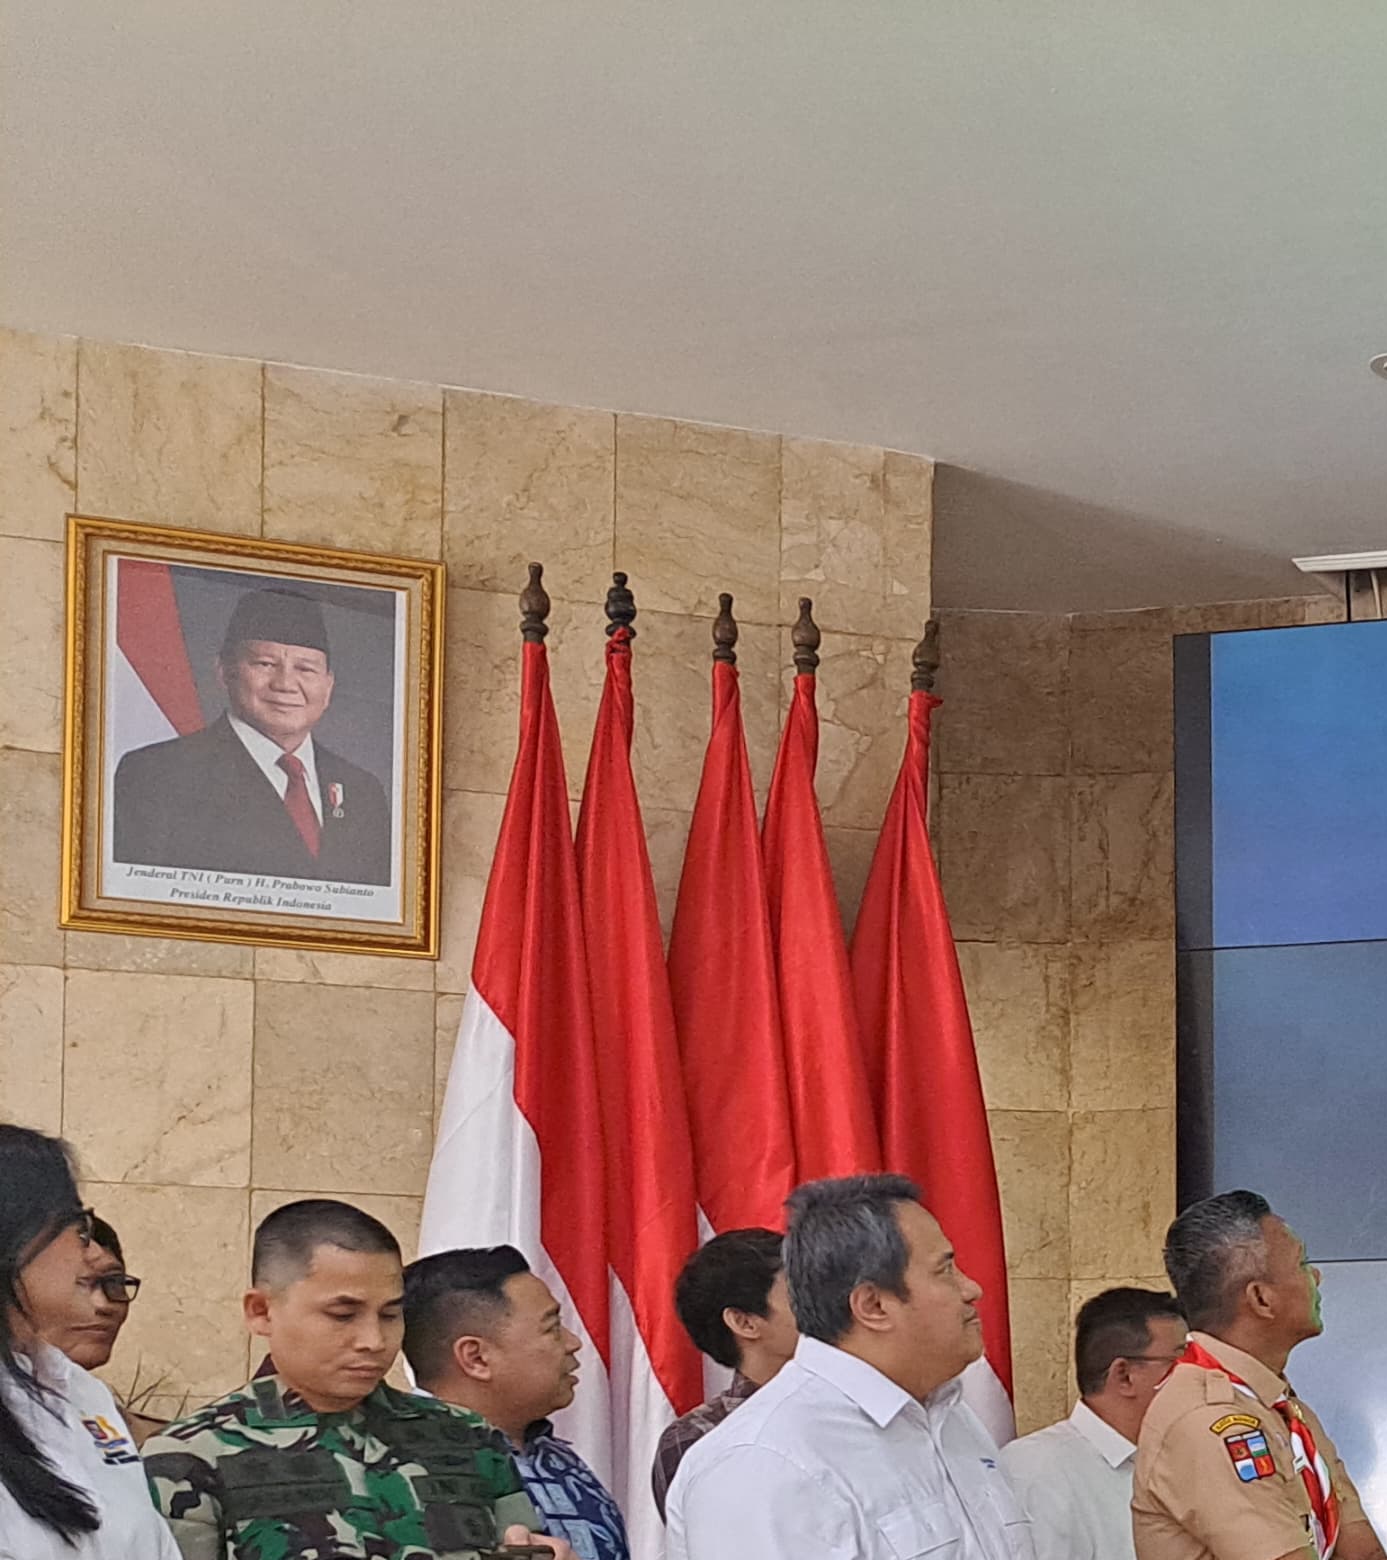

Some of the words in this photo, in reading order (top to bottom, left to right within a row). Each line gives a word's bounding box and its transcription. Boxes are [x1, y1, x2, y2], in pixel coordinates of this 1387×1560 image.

[126, 866, 177, 880] Jenderal
[181, 871, 204, 882] TNI
[272, 879, 322, 892] Prabowo
[324, 884, 375, 897] Subianto
[170, 887, 219, 901] Presiden
[223, 892, 273, 905] Republik
[276, 897, 332, 910] Indonesia
